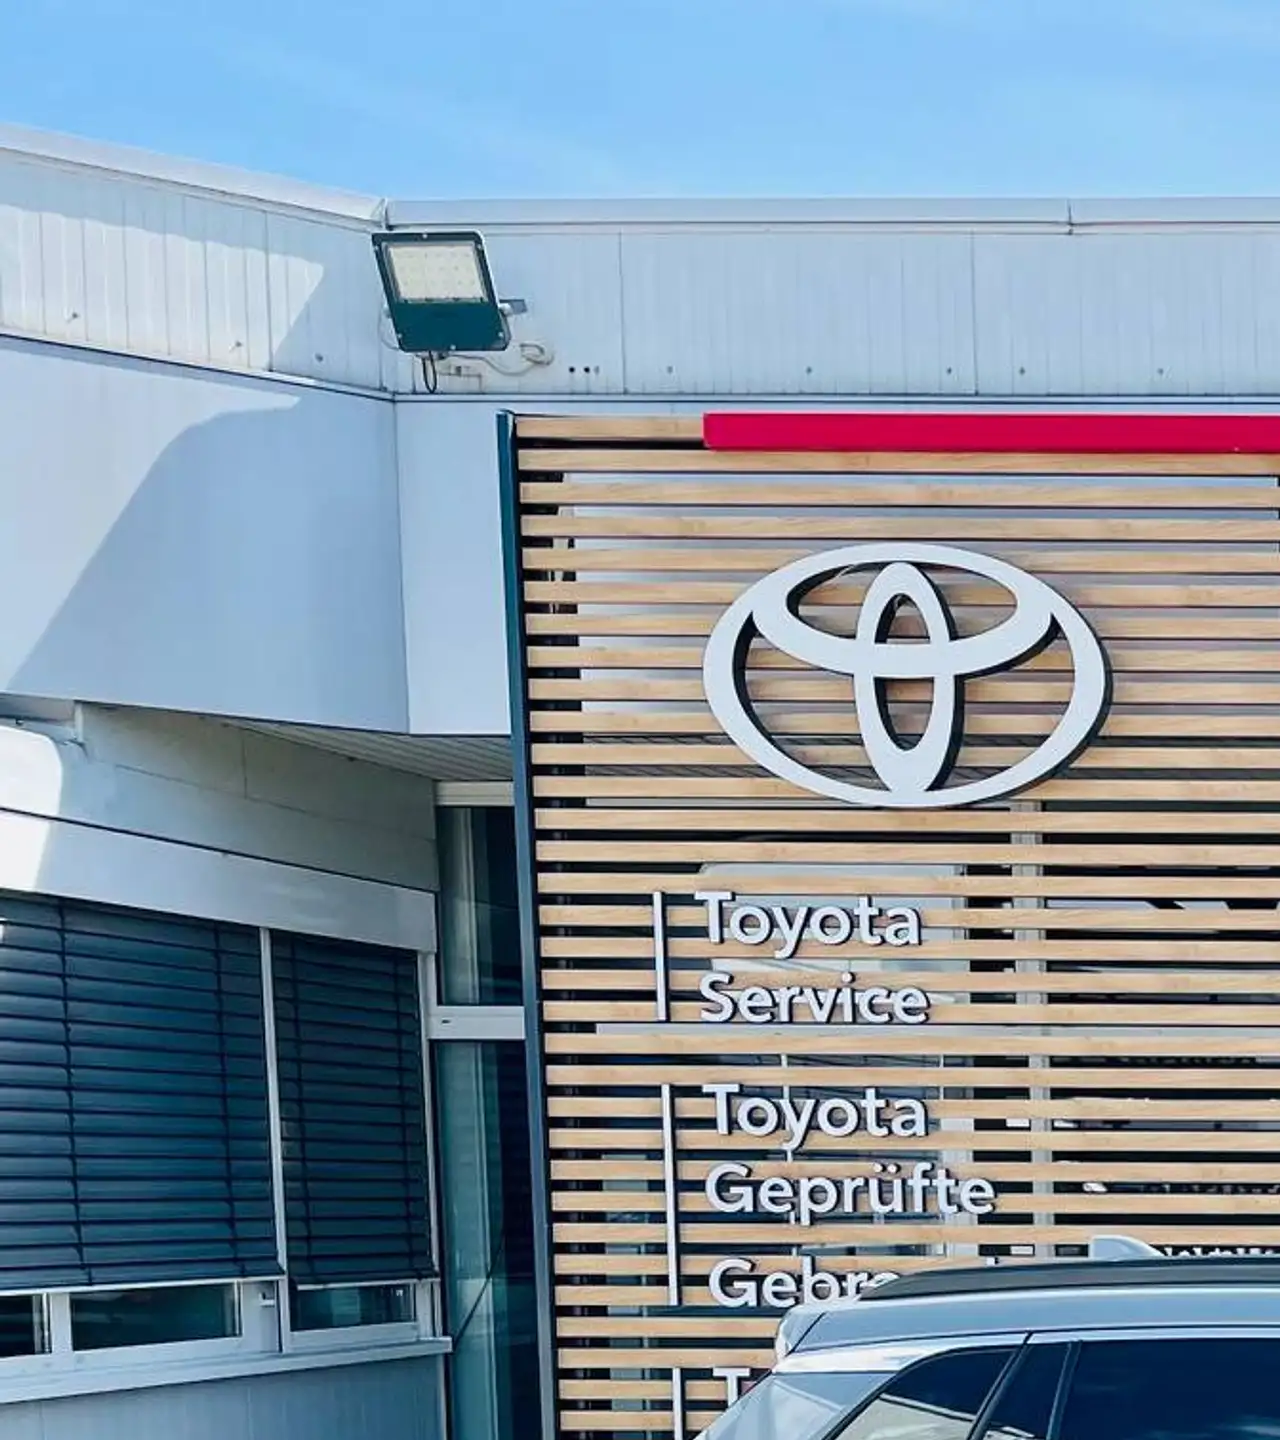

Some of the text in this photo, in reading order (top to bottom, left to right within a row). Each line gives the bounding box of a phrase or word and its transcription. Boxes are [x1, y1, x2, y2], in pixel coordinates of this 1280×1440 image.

[694, 891, 923, 959] Toyota
[699, 972, 930, 1024] Service
[702, 1084, 929, 1151] Toyota
[705, 1162, 998, 1227] Geprüfte
